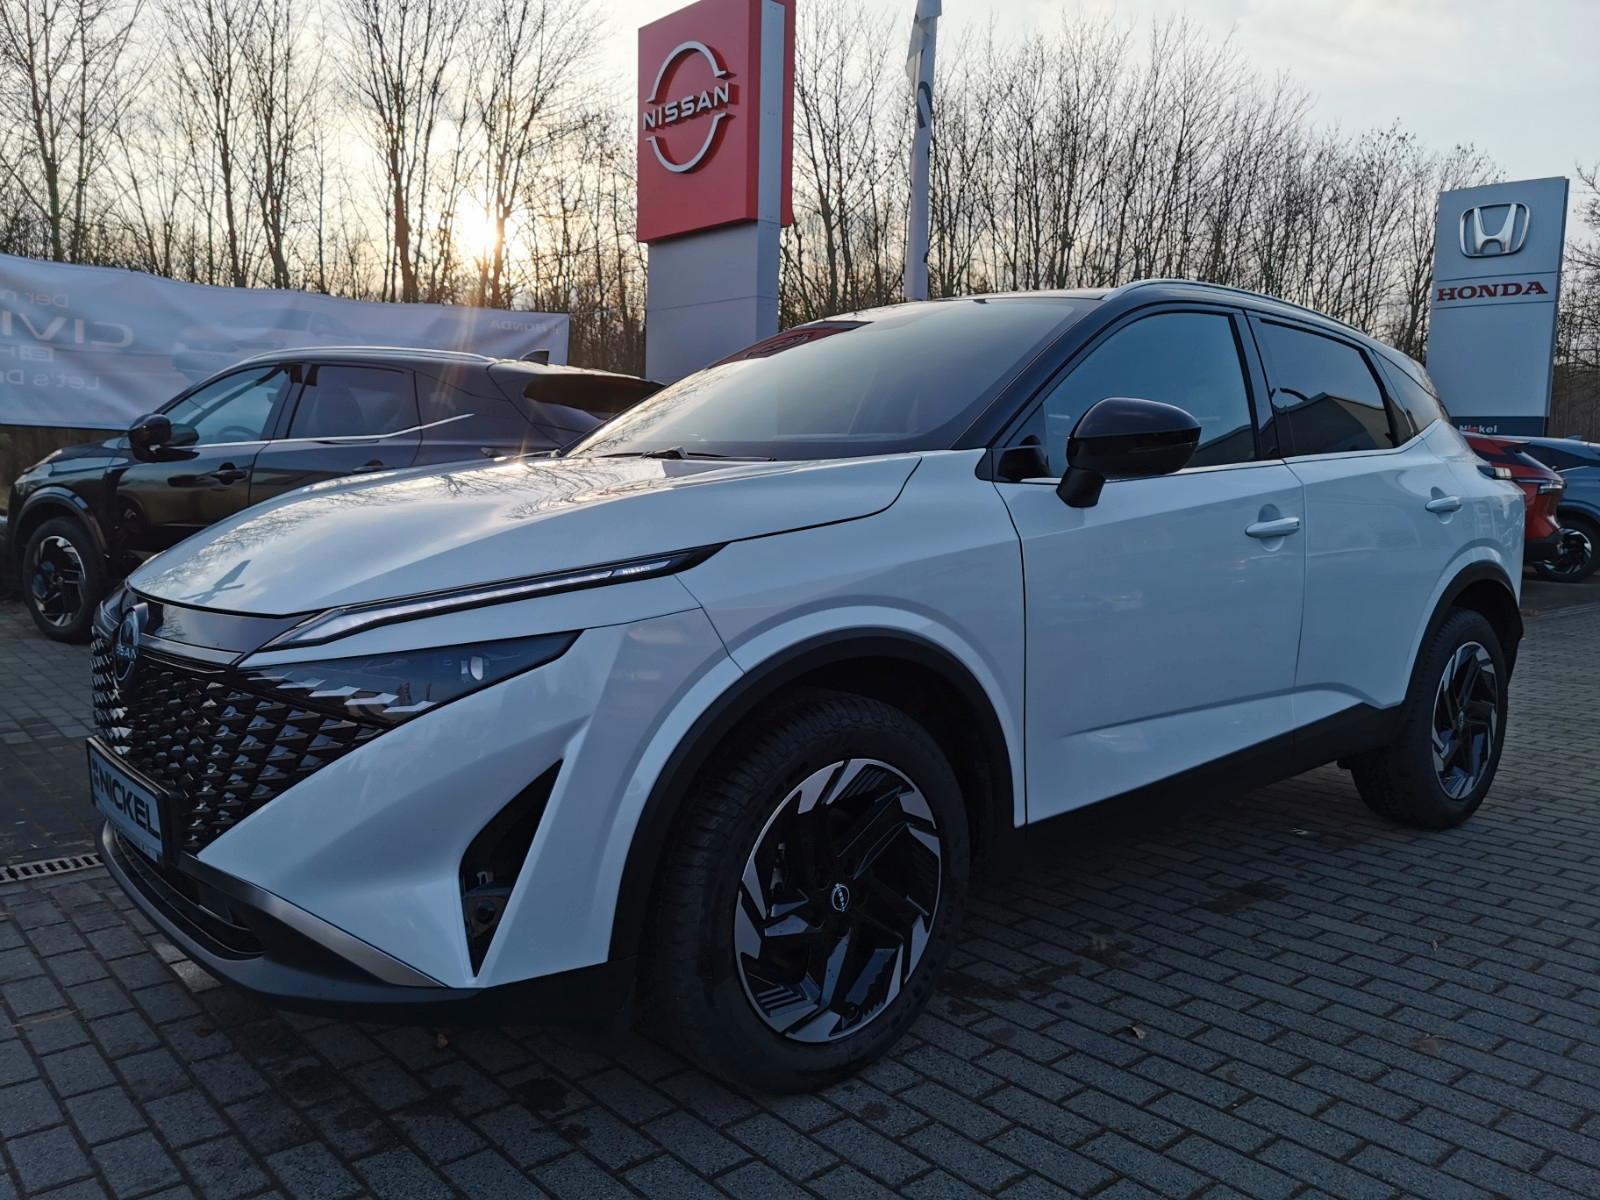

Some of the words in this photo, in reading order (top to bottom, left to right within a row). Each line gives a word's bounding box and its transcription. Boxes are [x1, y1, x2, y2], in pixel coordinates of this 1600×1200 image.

[643, 82, 729, 132] NISSAN
[1436, 280, 1548, 302] HONDA
[99, 766, 160, 840] NICKEL
